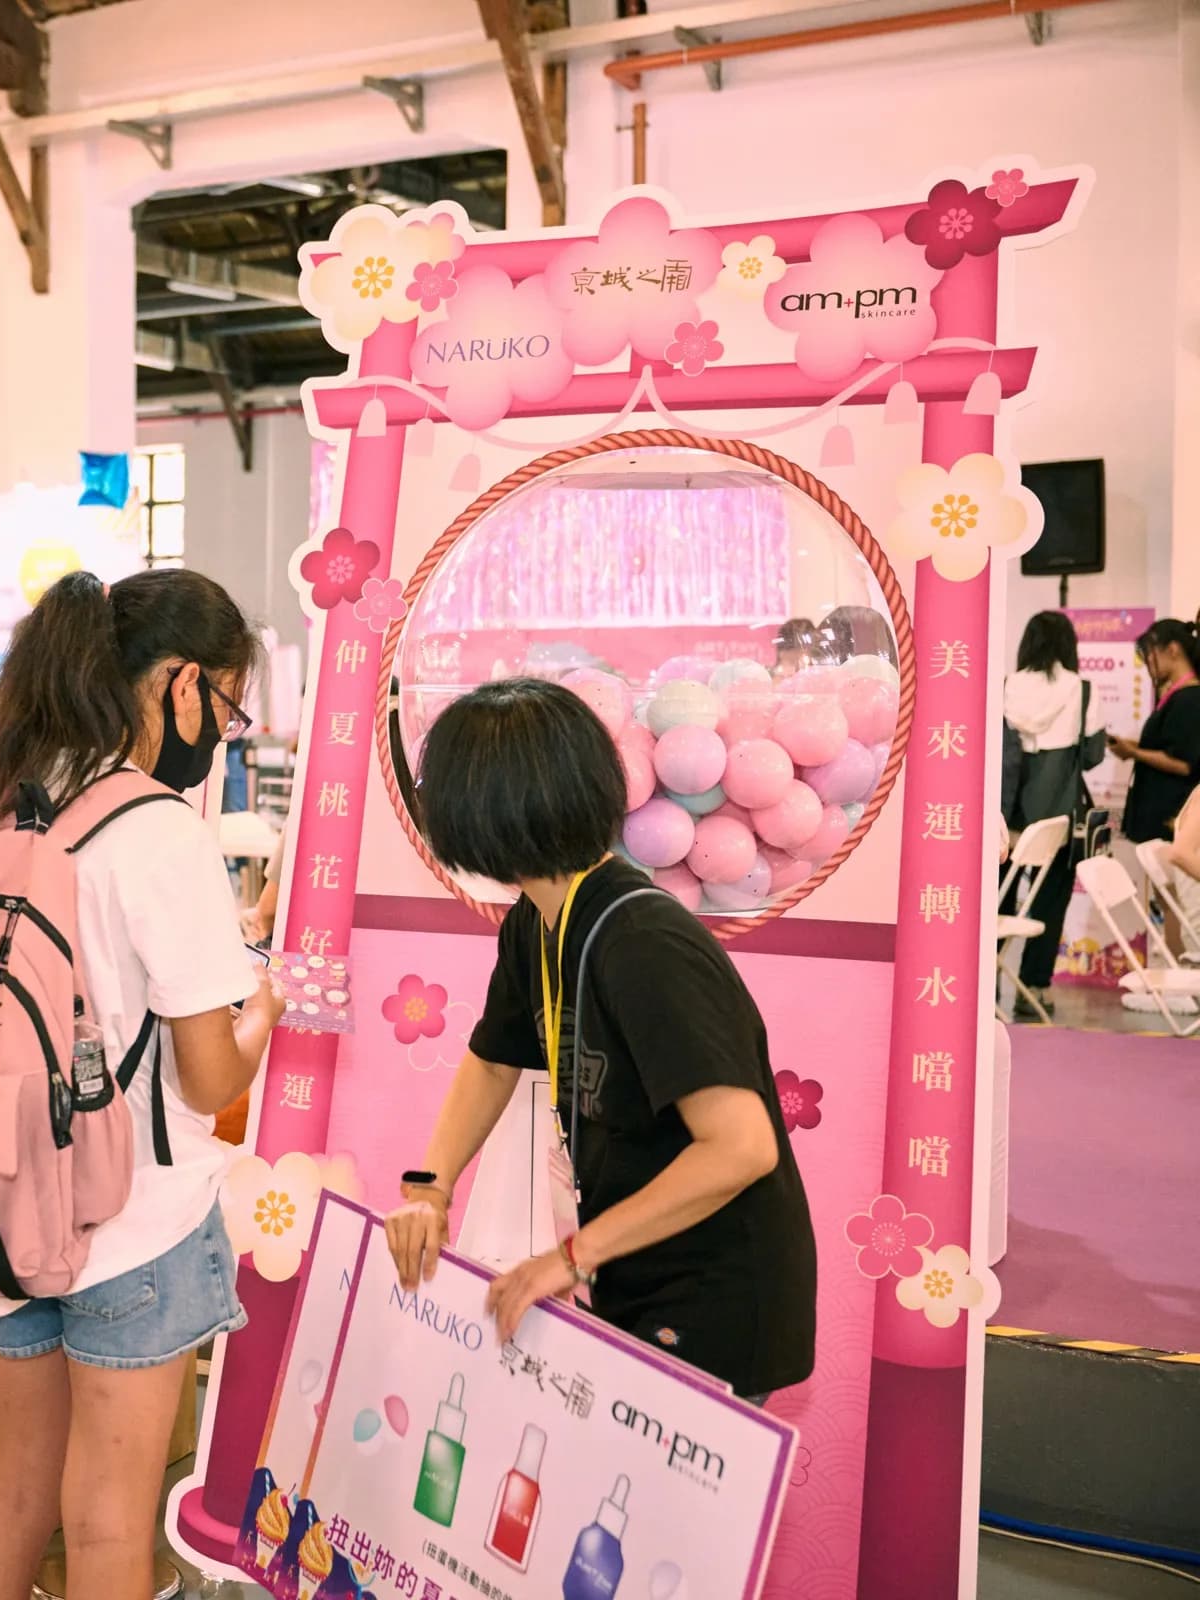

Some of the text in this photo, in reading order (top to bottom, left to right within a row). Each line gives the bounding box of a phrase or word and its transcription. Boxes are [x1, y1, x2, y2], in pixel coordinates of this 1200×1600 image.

[570, 258, 693, 296] 京城之霜
[861, 308, 916, 319] skincare
[280, 638, 368, 1113] 仲夏桃花好運
[907, 638, 971, 1179] 美來運轉水噹噹
[499, 1337, 595, 1420] 京城之霜
[327, 1512, 458, 1600] 扭出妳的夏
